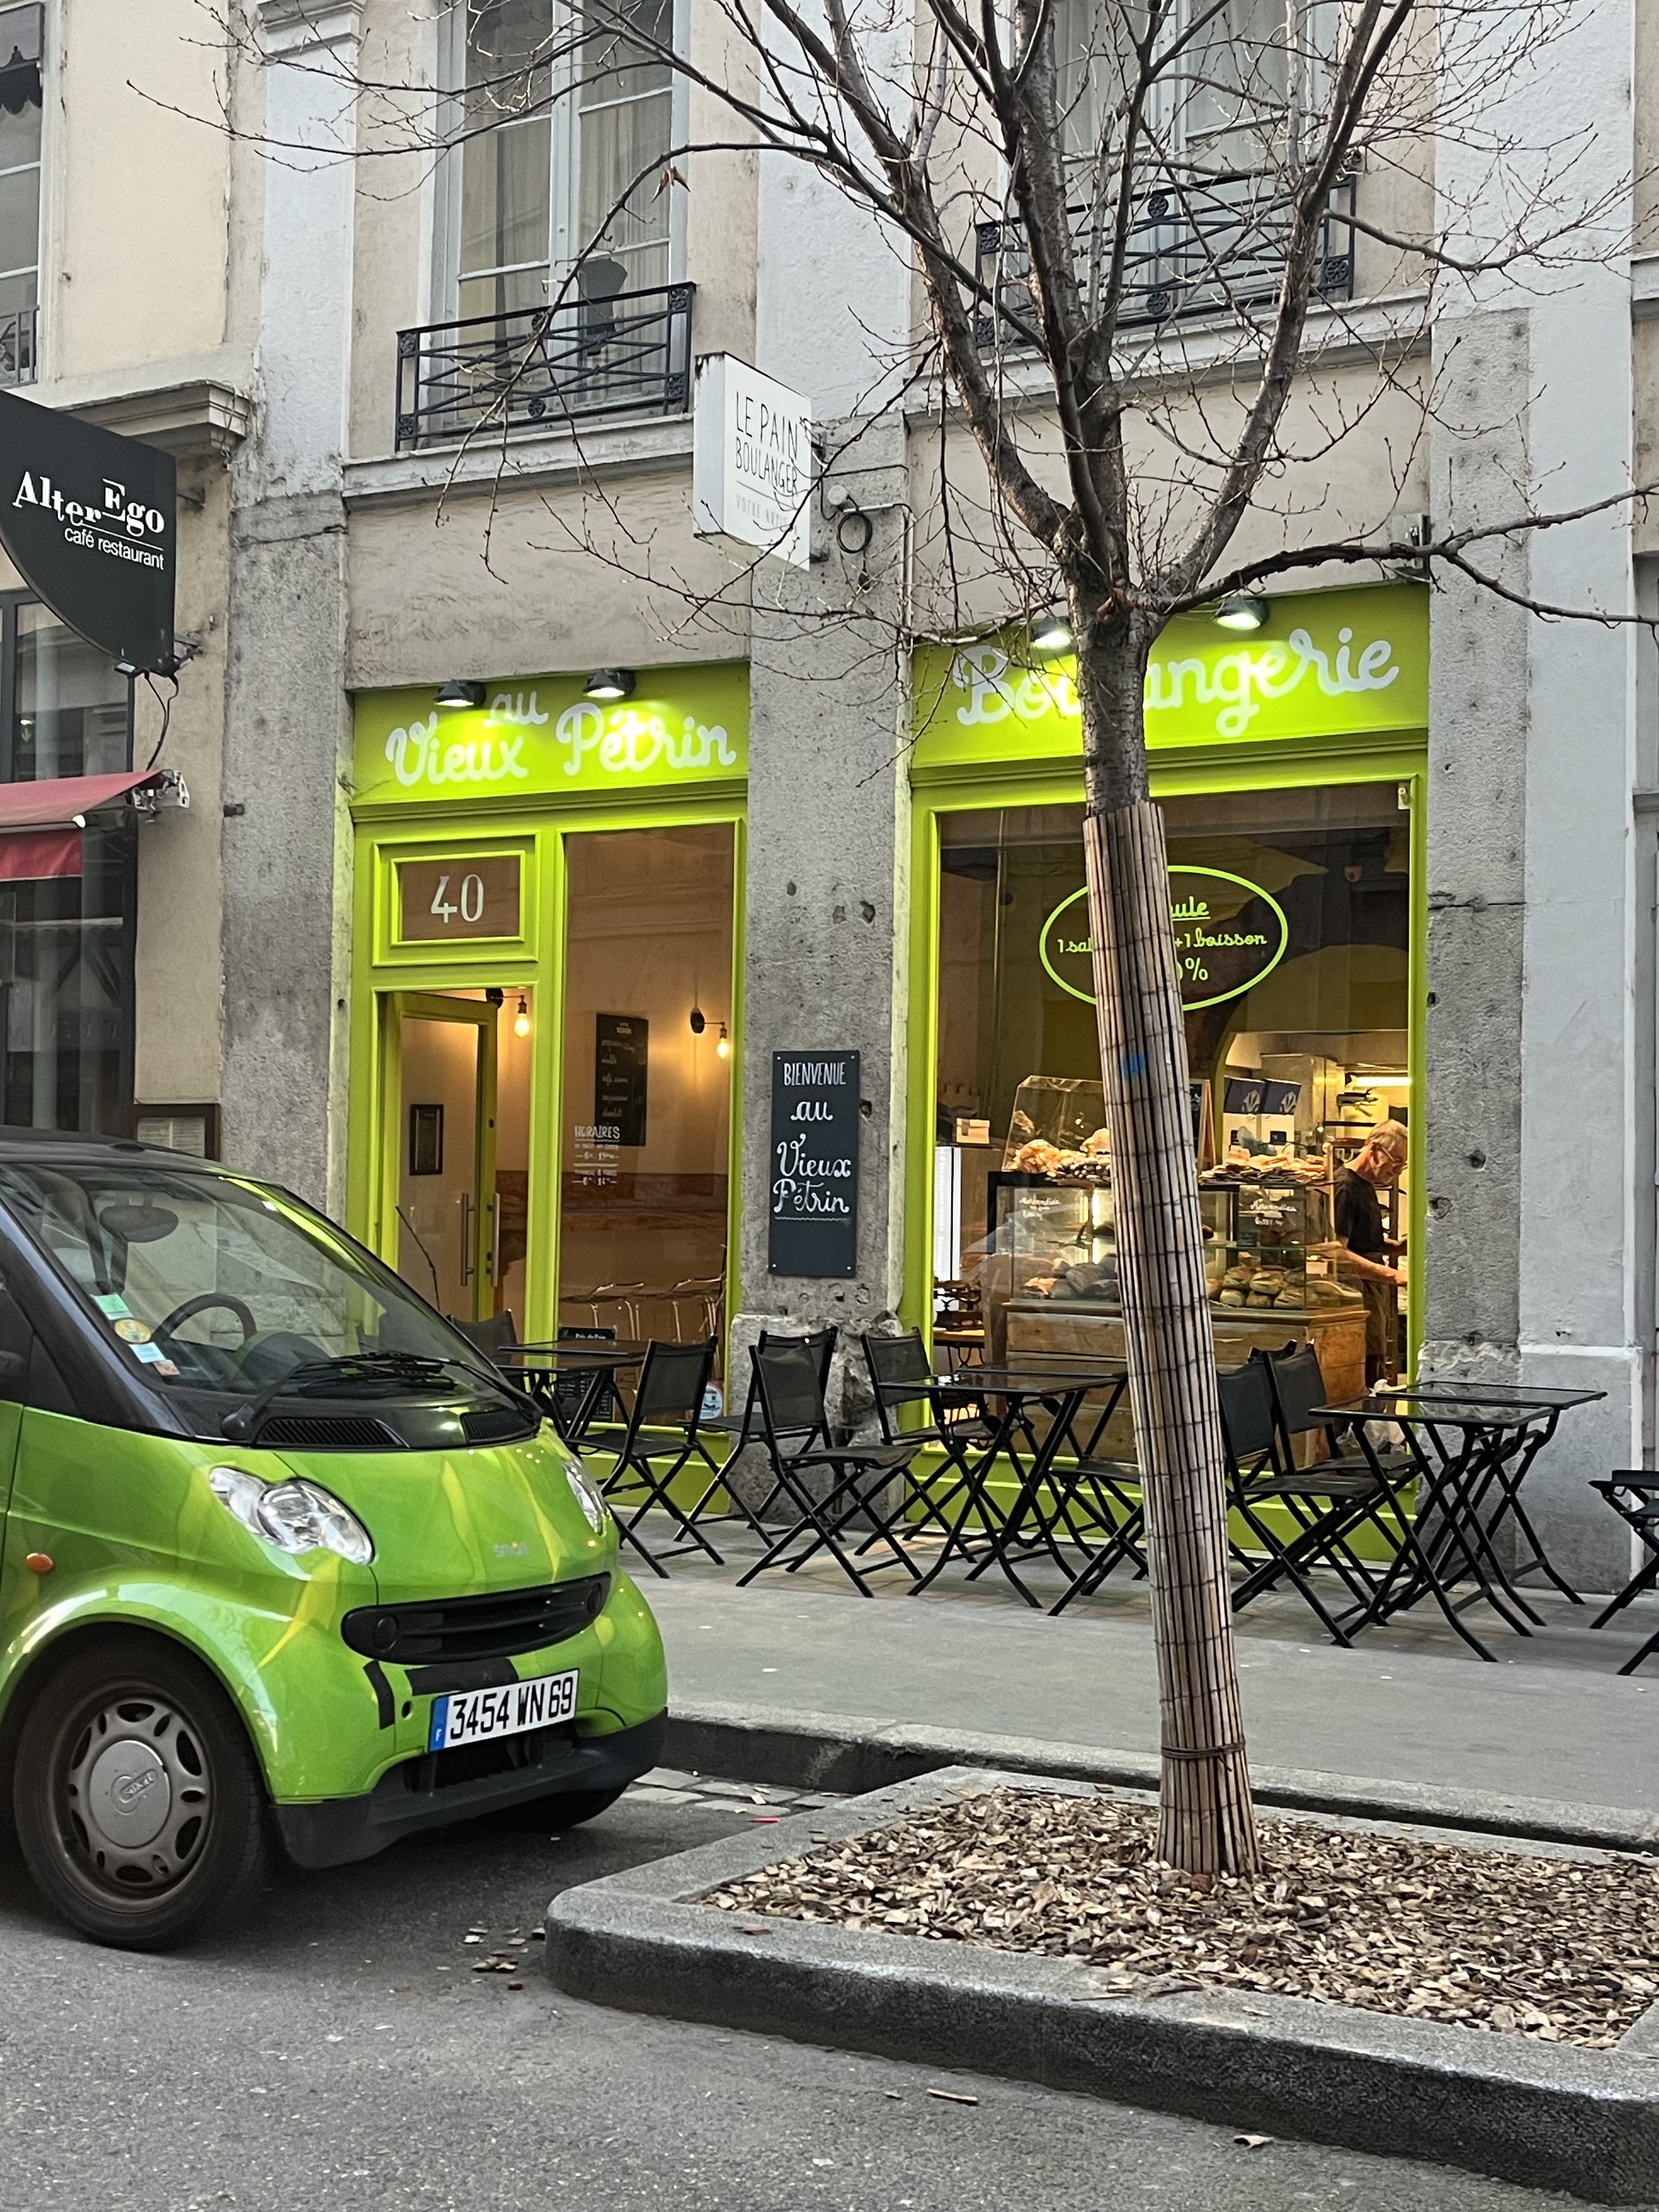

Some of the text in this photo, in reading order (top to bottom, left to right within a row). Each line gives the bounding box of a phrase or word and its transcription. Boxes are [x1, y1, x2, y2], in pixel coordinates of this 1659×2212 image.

[736, 391, 799, 460] LE PAIN
[736, 436, 799, 495] BOULANGER
[12, 471, 165, 537] Alter Ego
[64, 526, 164, 571] café restaurant
[484, 691, 549, 727] au
[385, 702, 737, 787] Vieux Pétrin
[431, 873, 484, 923] 40
[1193, 927, 1268, 947] boisson
[783, 1062, 847, 1086] BIENVENUE
[574, 1125, 620, 1139] HORAIRES
[789, 1101, 833, 1121] au
[776, 1132, 851, 1177] Vieux
[772, 1177, 850, 1214] Pétrin
[450, 1690, 510, 1740] 3454
[548, 1676, 574, 1719] 69
